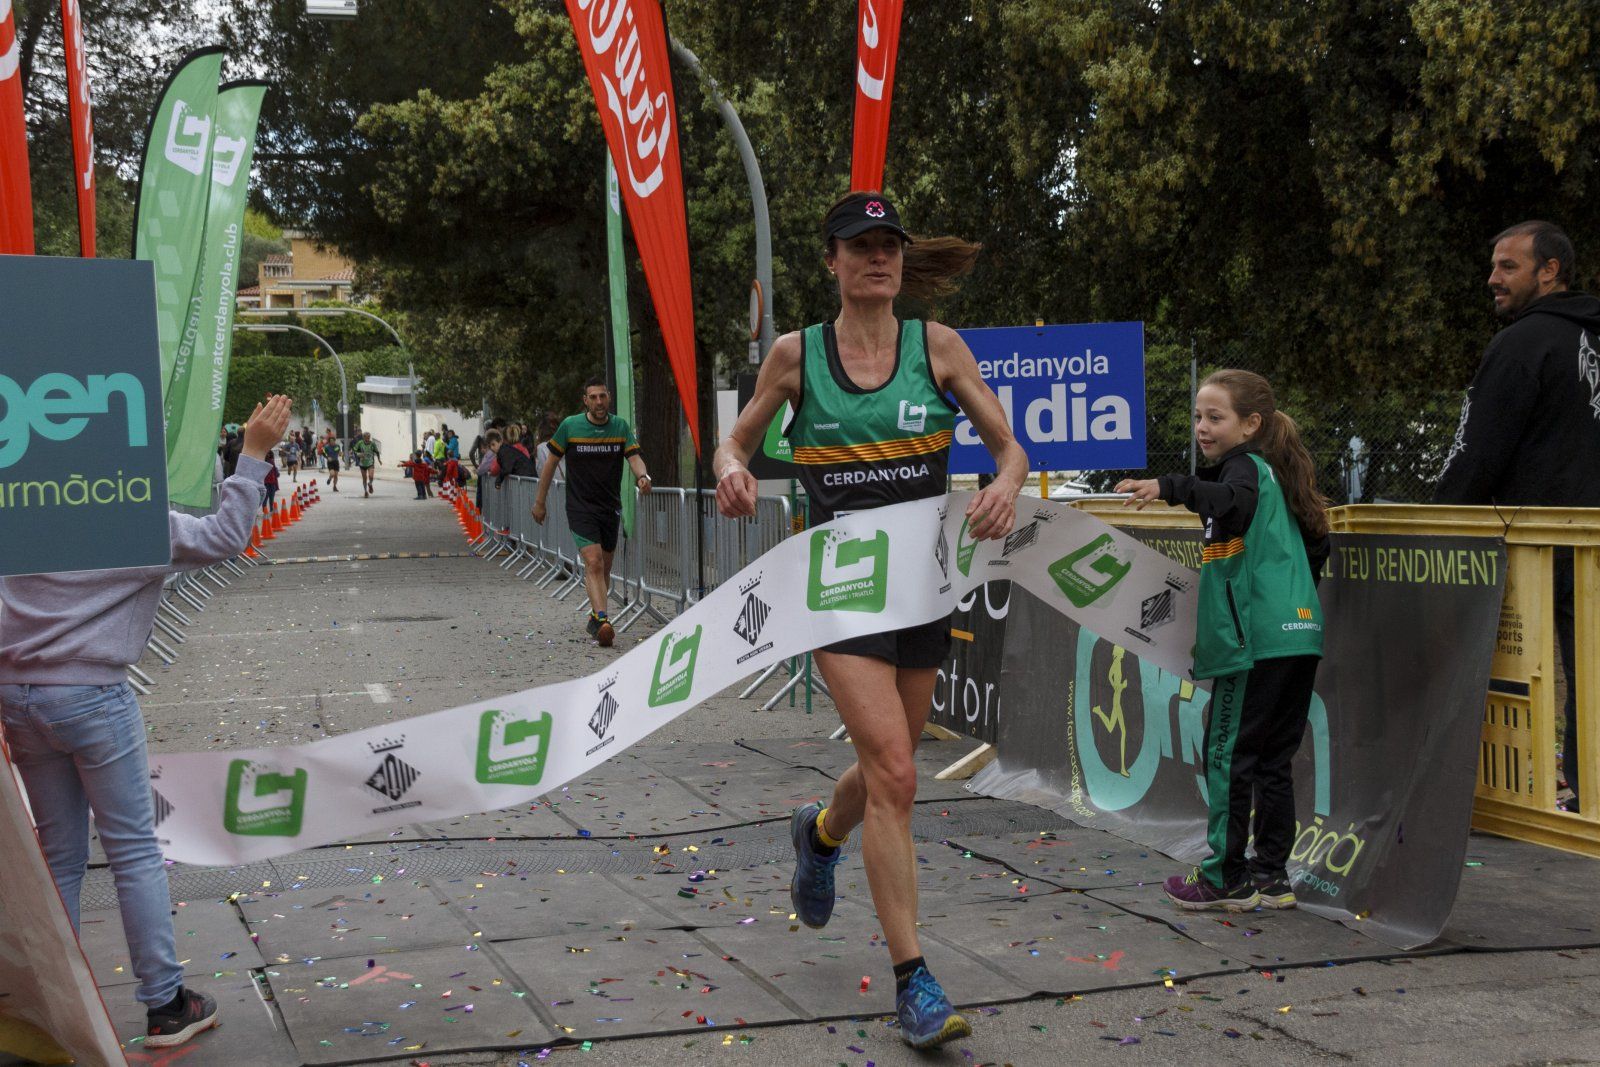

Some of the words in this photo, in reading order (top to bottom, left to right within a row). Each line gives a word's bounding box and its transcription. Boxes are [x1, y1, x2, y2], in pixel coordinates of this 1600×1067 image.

[212, 223, 238, 411] www.atcerdanyola.club
[1024, 382, 1132, 443] dia
[823, 464, 929, 486] CERDANYOLA
[1339, 547, 1369, 580] TEU
[1377, 549, 1498, 586] RENDIMENT
[820, 579, 875, 598] CERDANYOLA
[656, 672, 687, 696] CERDANYOLA
[1213, 675, 1238, 770] CERDANYOLA
